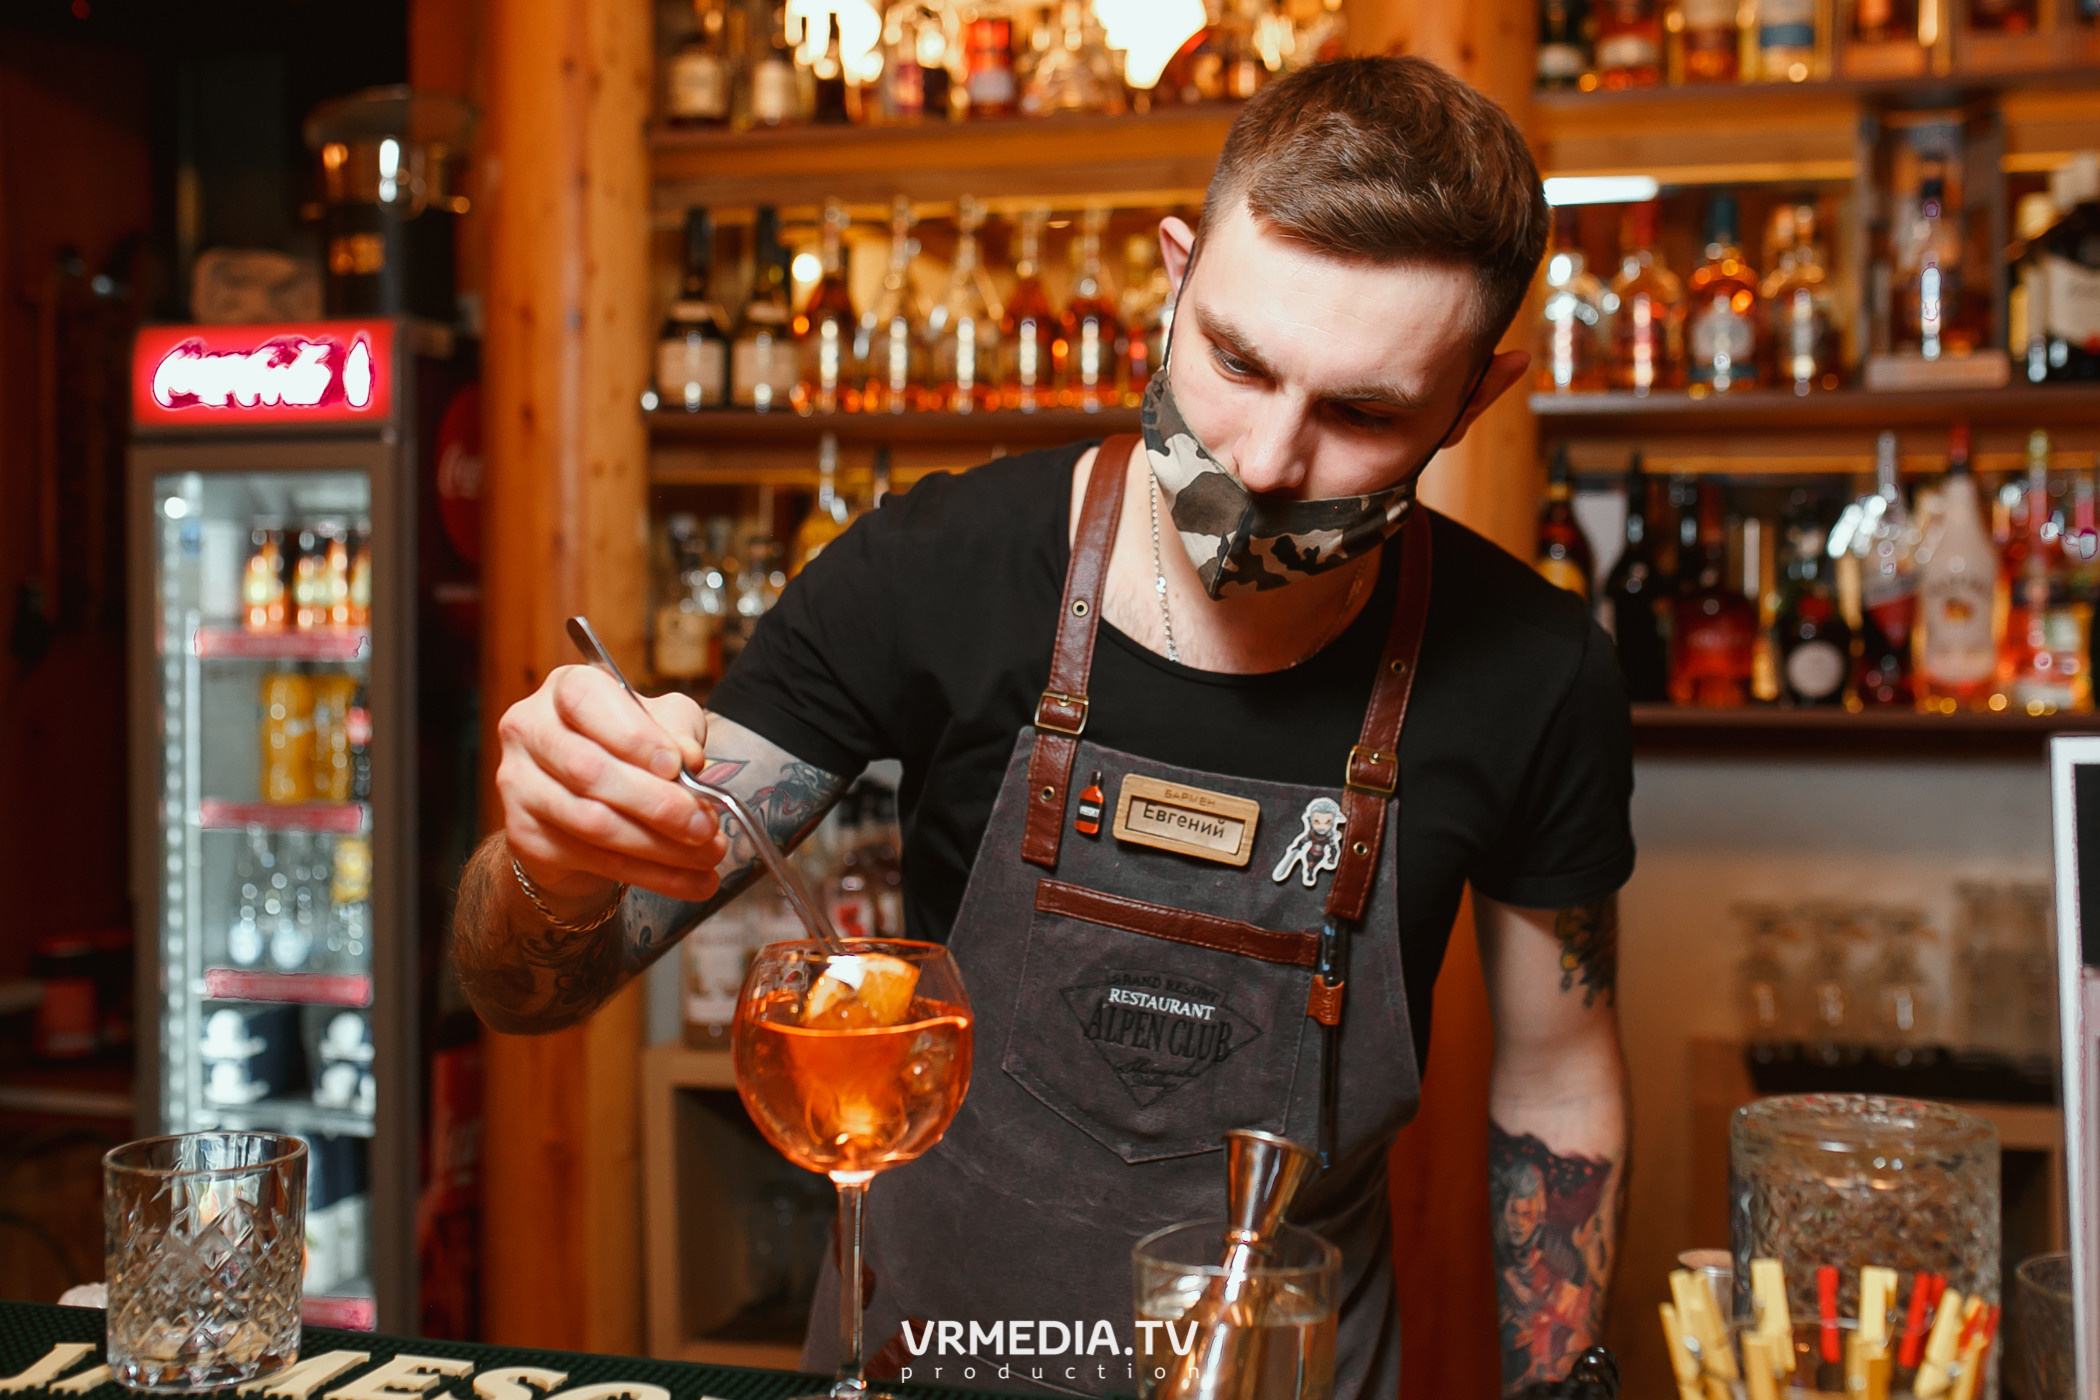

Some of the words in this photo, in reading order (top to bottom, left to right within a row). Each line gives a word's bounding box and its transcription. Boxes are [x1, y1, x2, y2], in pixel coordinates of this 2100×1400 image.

[1164, 788, 1217, 808] БАРМЕН
[1143, 803, 1226, 838] Евгений
[1108, 987, 1216, 1020] RESTAURANT
[1165, 979, 1220, 1003] RESORT
[1084, 996, 1167, 1051] ALPEN
[1168, 1018, 1234, 1063] CLUB
